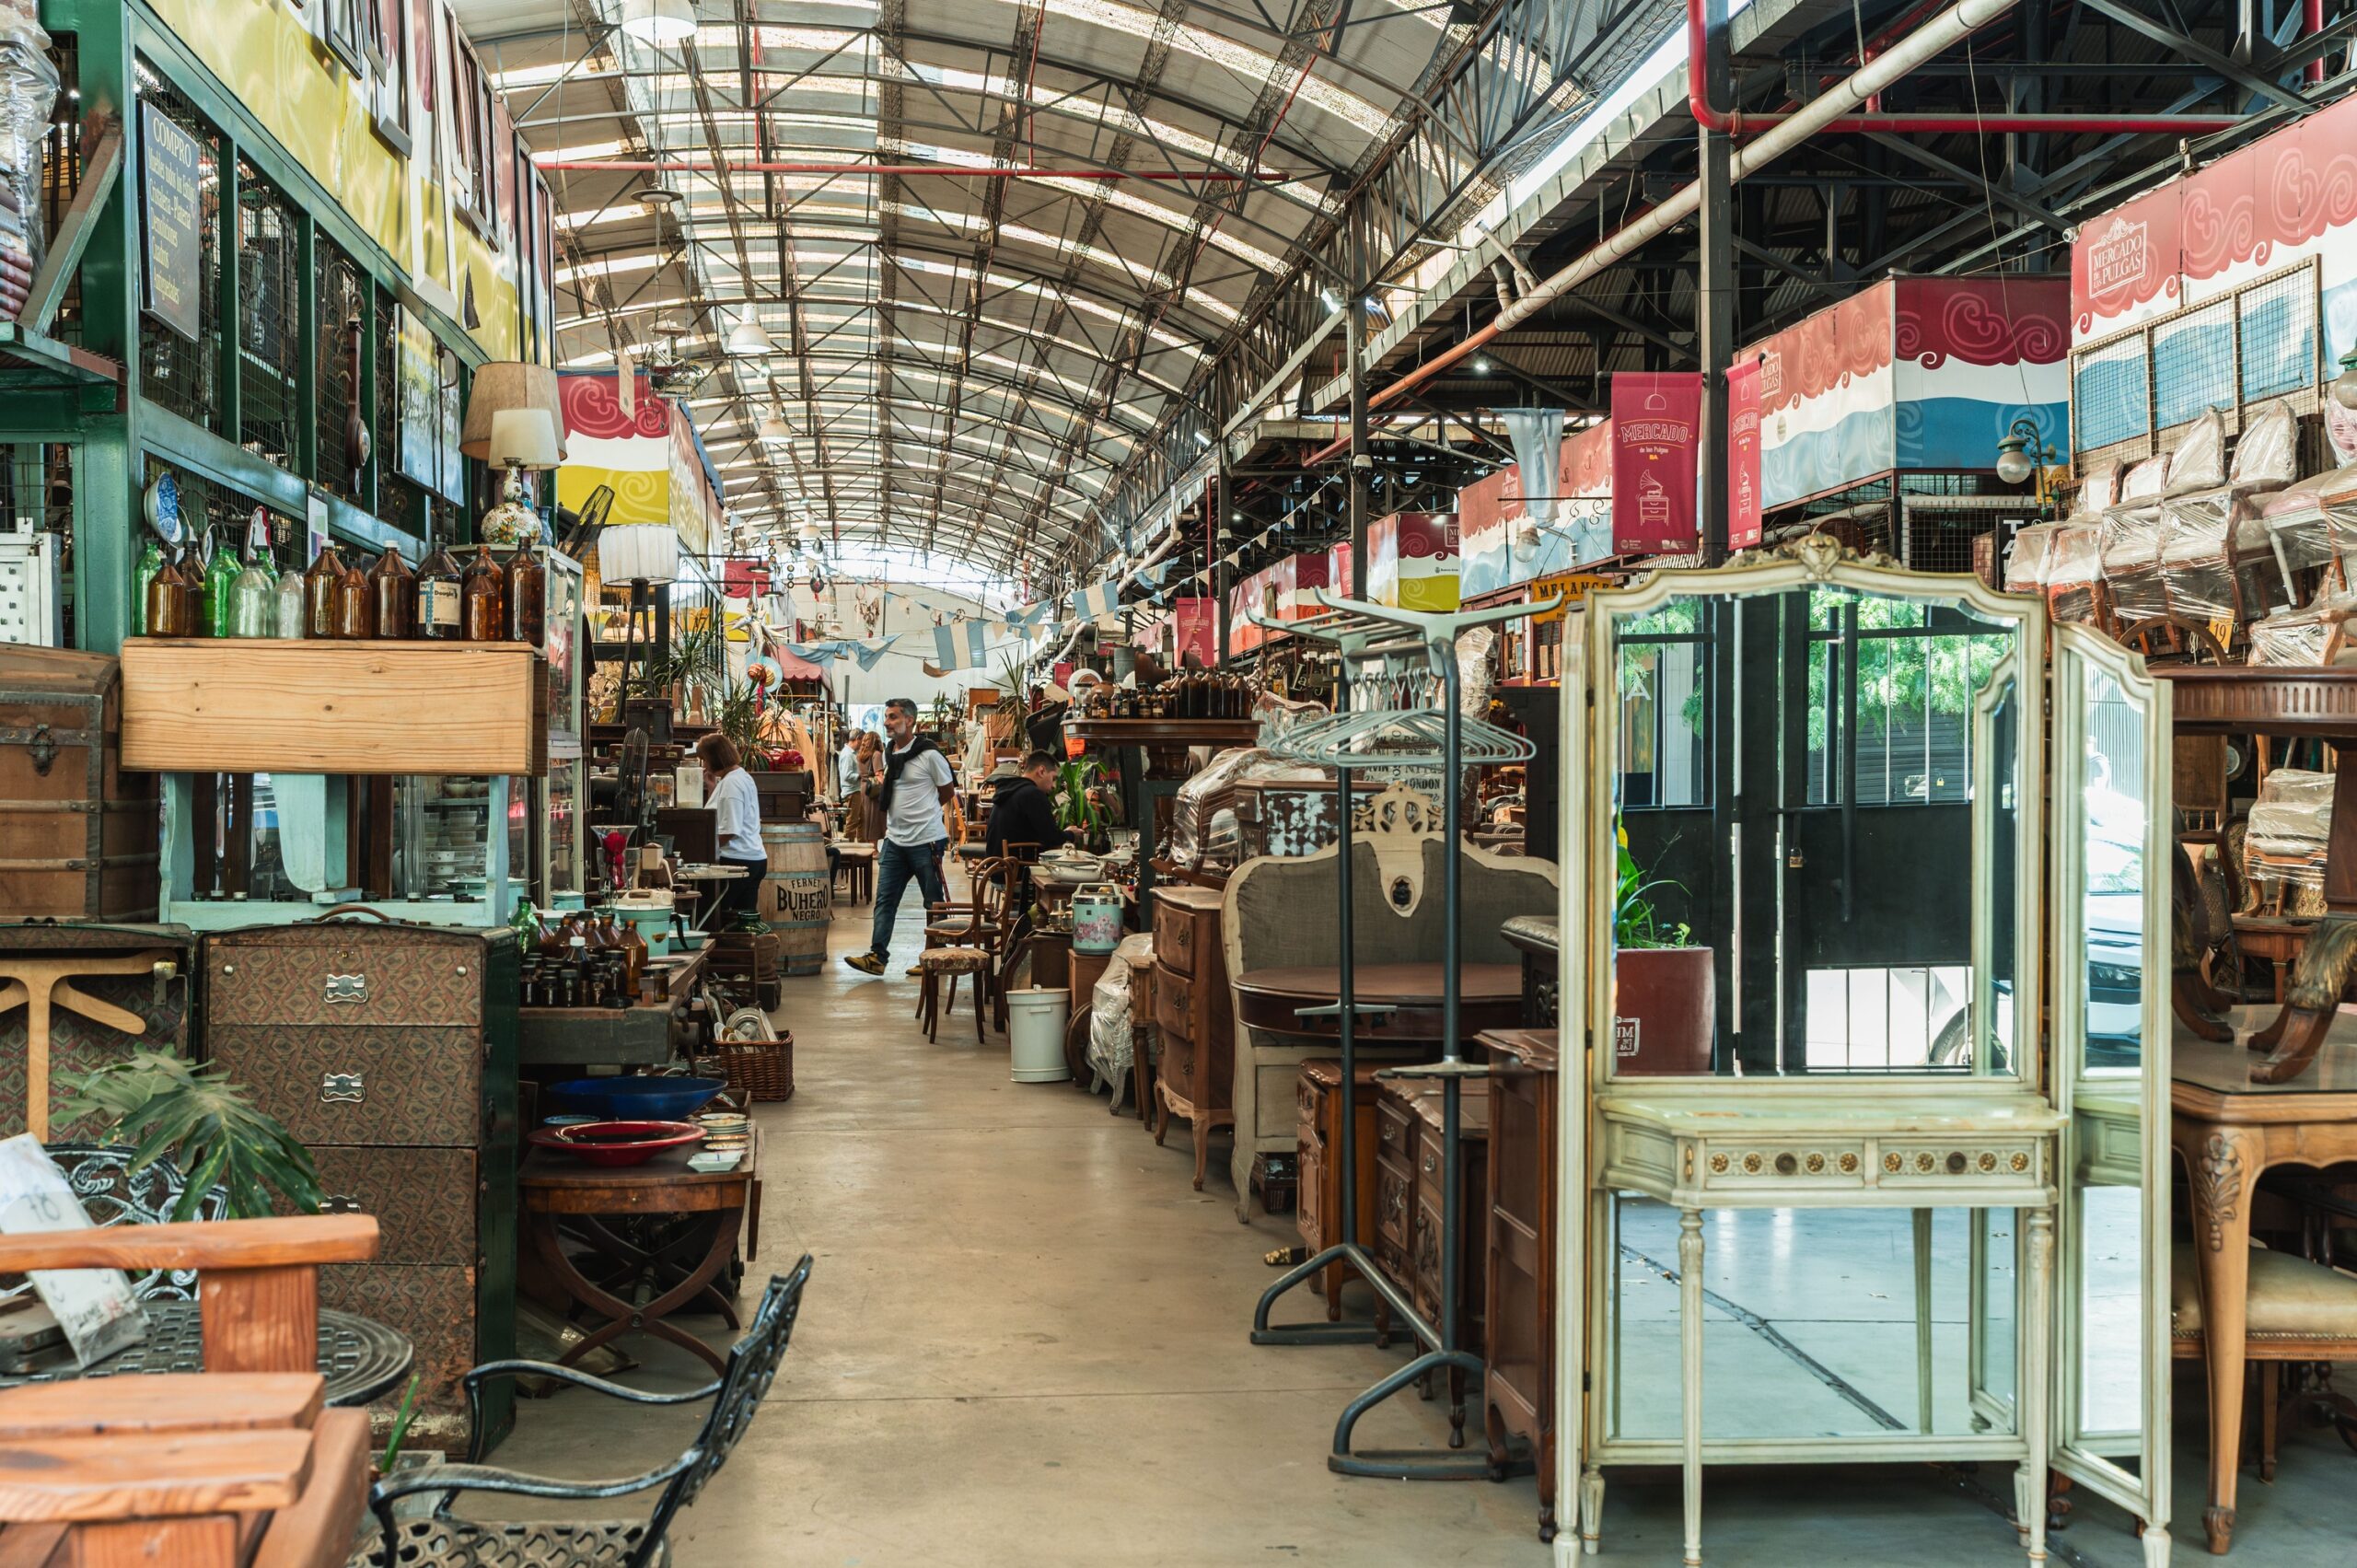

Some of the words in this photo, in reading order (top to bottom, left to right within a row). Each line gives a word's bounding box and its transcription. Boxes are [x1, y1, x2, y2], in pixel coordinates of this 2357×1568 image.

[153, 117, 192, 168] COMPRO
[2093, 235, 2142, 271] MERCADO
[2103, 252, 2142, 285] PULGAS
[1620, 424, 1689, 442] MERCADO
[2214, 623, 2226, 643] 19
[791, 877, 820, 889] FERNET
[777, 884, 829, 912] BUHERO
[793, 910, 820, 921] NEGRO
